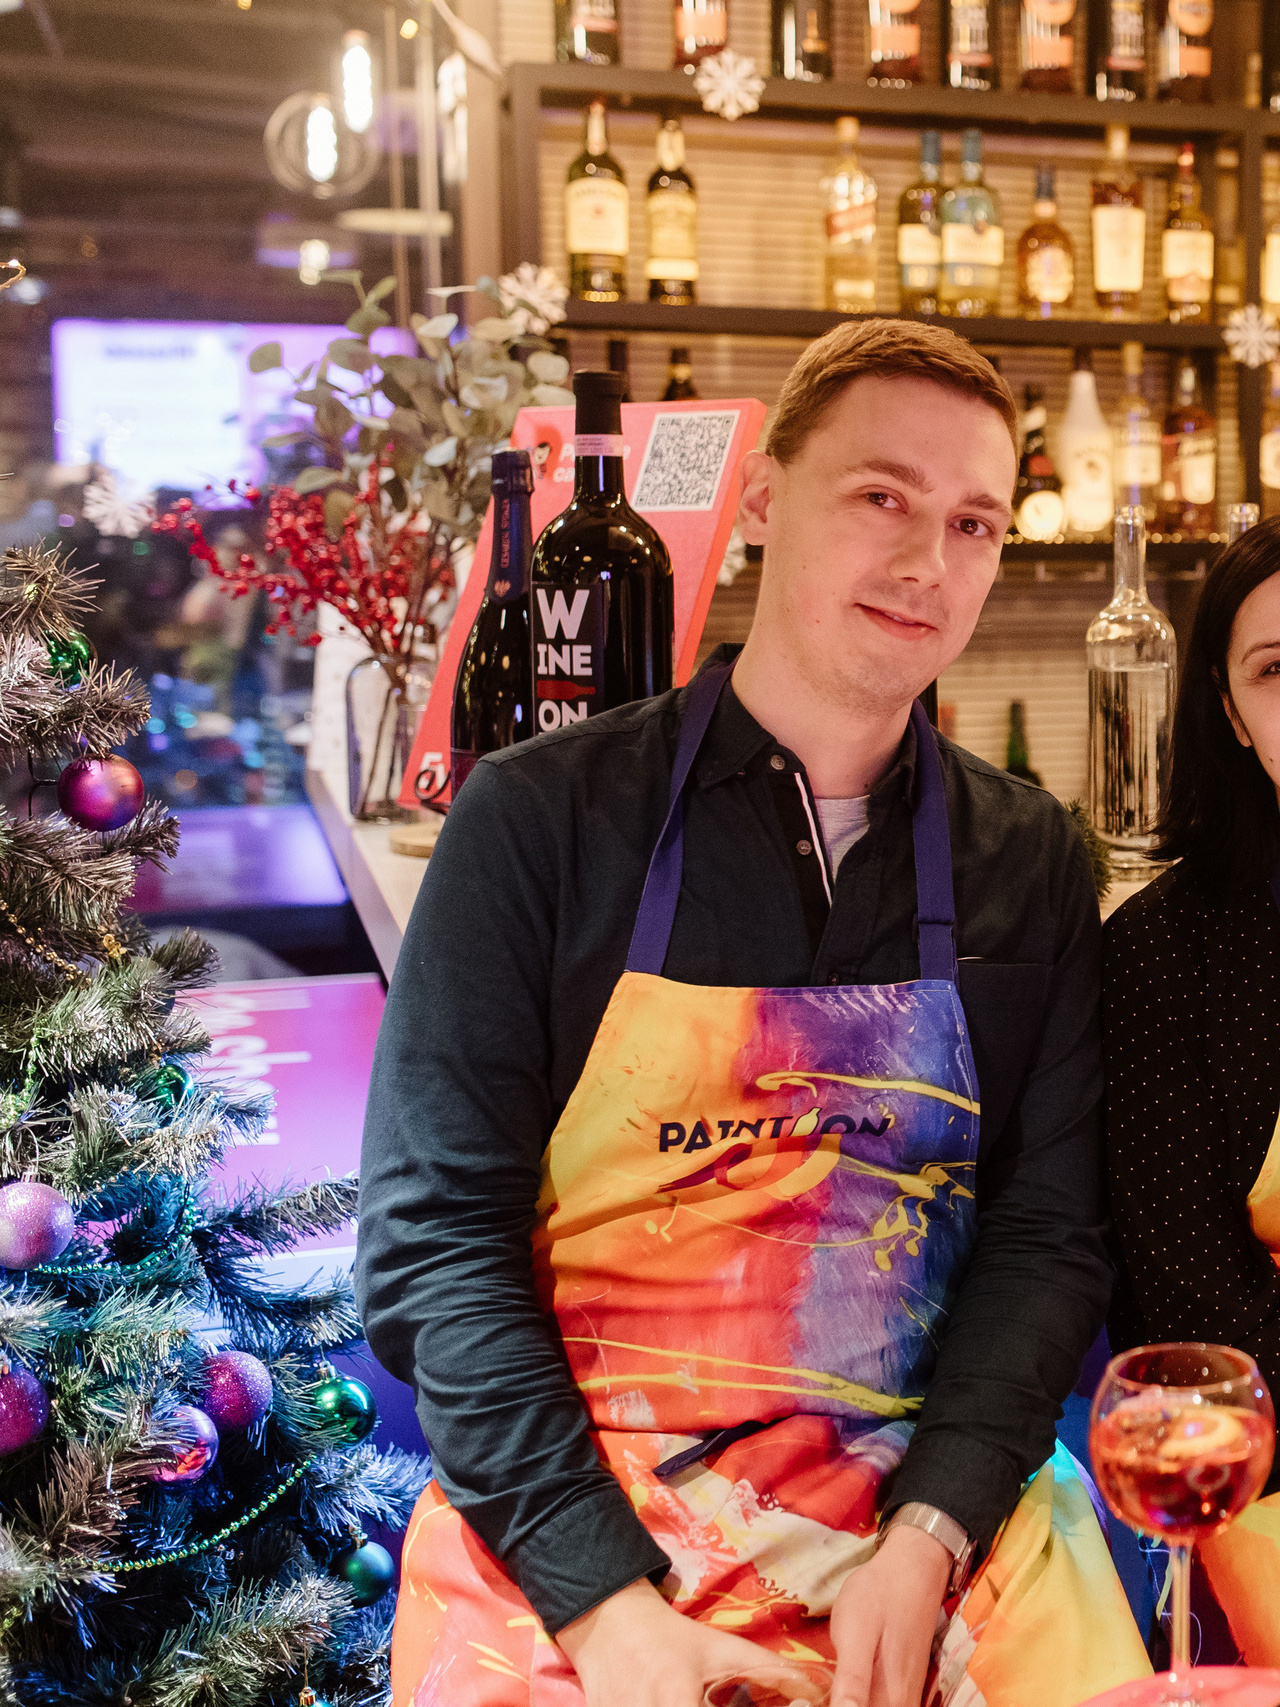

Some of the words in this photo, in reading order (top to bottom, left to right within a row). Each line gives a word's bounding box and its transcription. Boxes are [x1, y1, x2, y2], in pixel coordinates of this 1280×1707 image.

[536, 588, 590, 640] W
[537, 643, 593, 676] INE
[538, 700, 588, 732] ON
